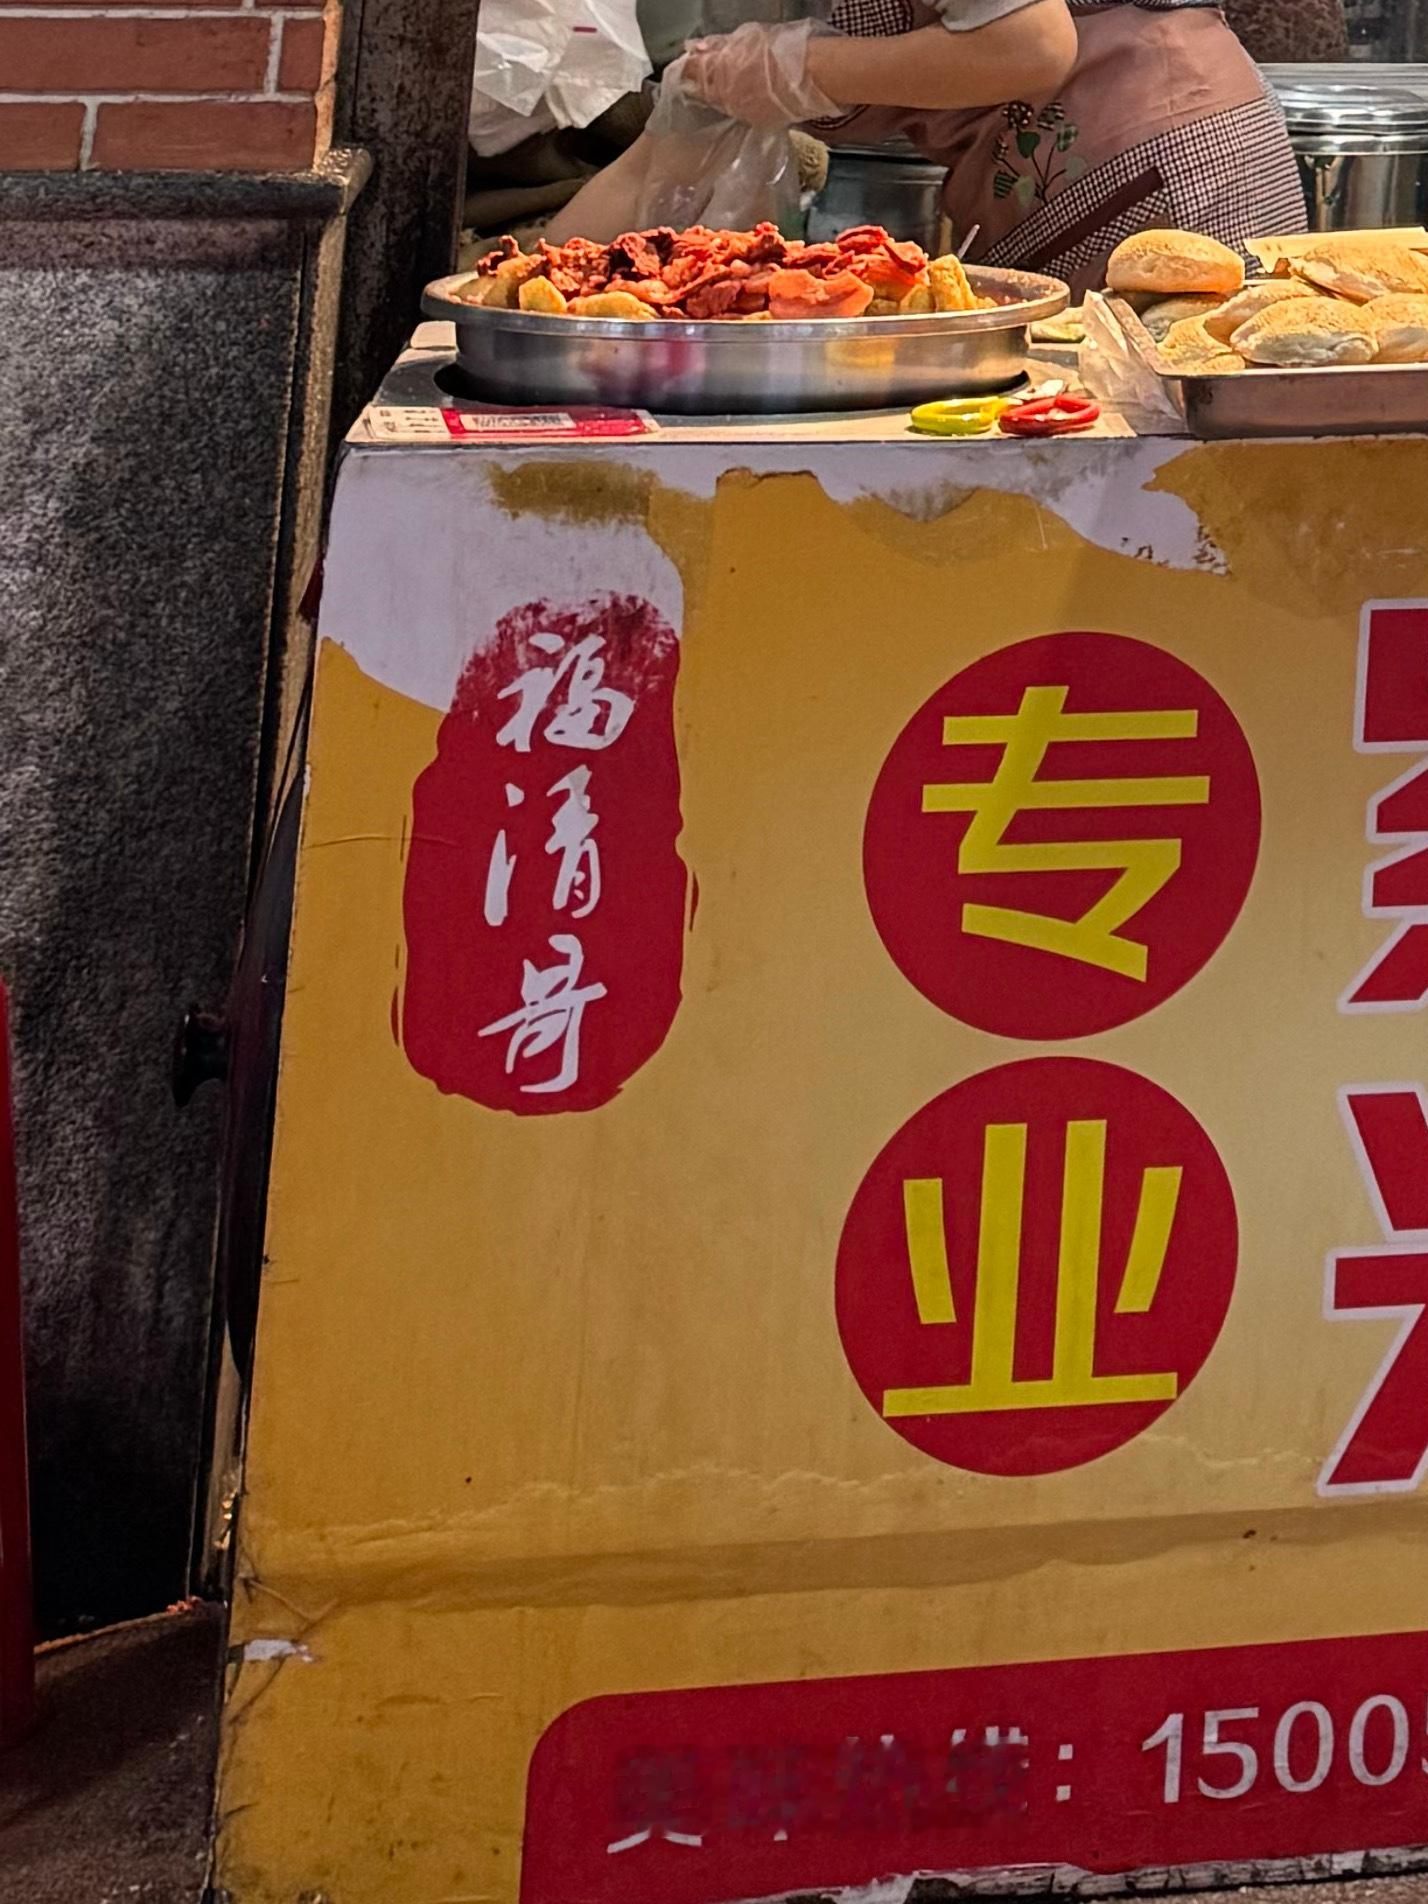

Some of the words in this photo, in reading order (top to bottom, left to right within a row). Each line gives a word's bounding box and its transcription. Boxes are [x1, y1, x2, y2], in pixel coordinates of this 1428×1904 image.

[479, 630, 634, 1094] 福清哥
[881, 684, 1210, 1418] 专业
